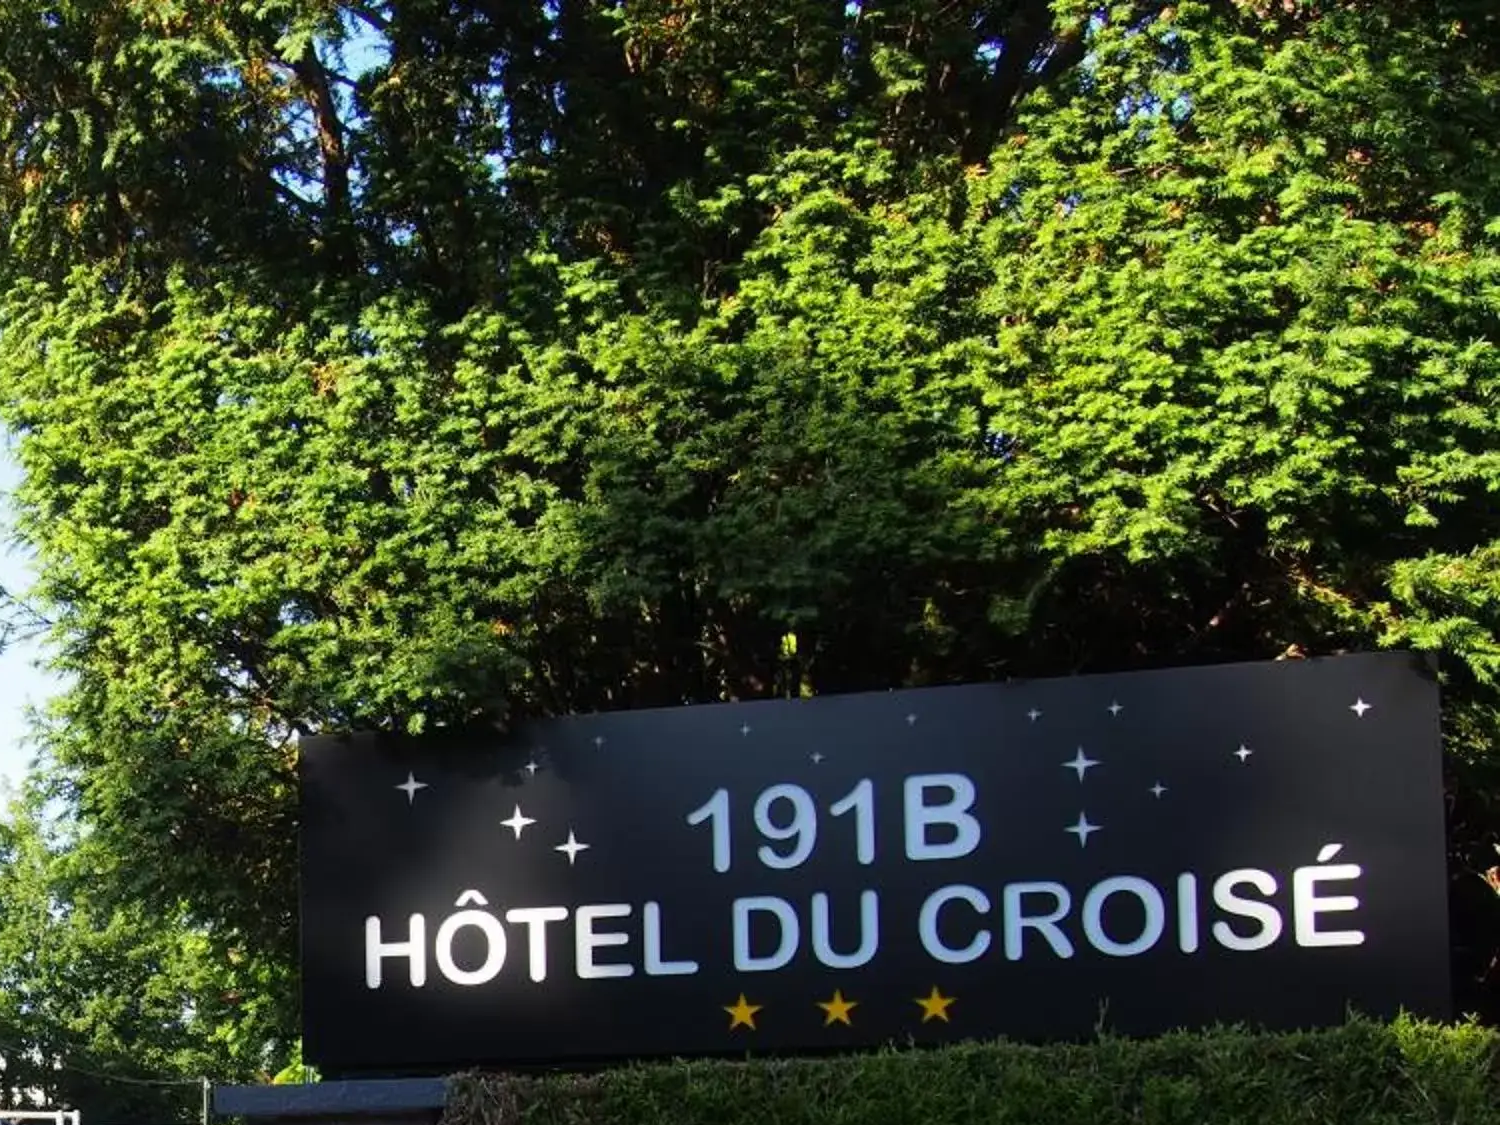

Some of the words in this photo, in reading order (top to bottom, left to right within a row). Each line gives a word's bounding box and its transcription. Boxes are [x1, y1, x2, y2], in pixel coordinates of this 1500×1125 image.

[687, 773, 981, 873] 191B
[365, 889, 699, 989] HÔTEL
[732, 890, 879, 971] DU
[918, 843, 1365, 964] CROISÉ
